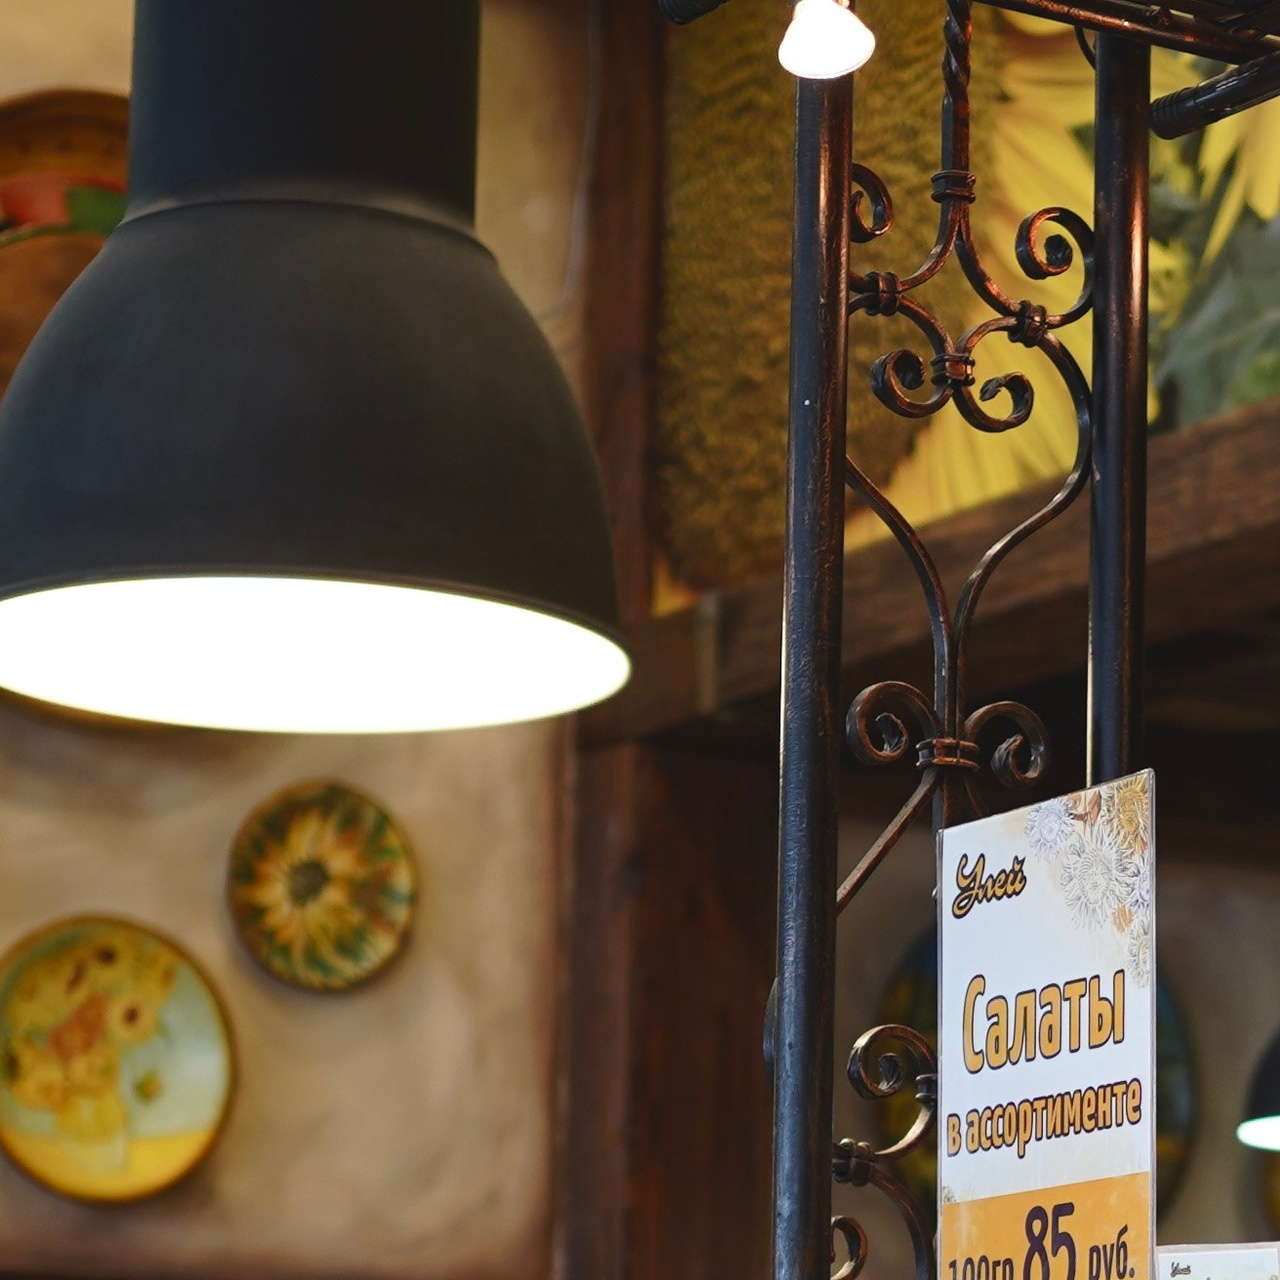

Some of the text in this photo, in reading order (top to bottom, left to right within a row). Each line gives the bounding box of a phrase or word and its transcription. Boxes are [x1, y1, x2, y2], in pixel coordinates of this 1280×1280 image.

[951, 852, 1028, 919] Улей
[962, 969, 1126, 1076] Салаты
[947, 1078, 1143, 1160] в ассортименте
